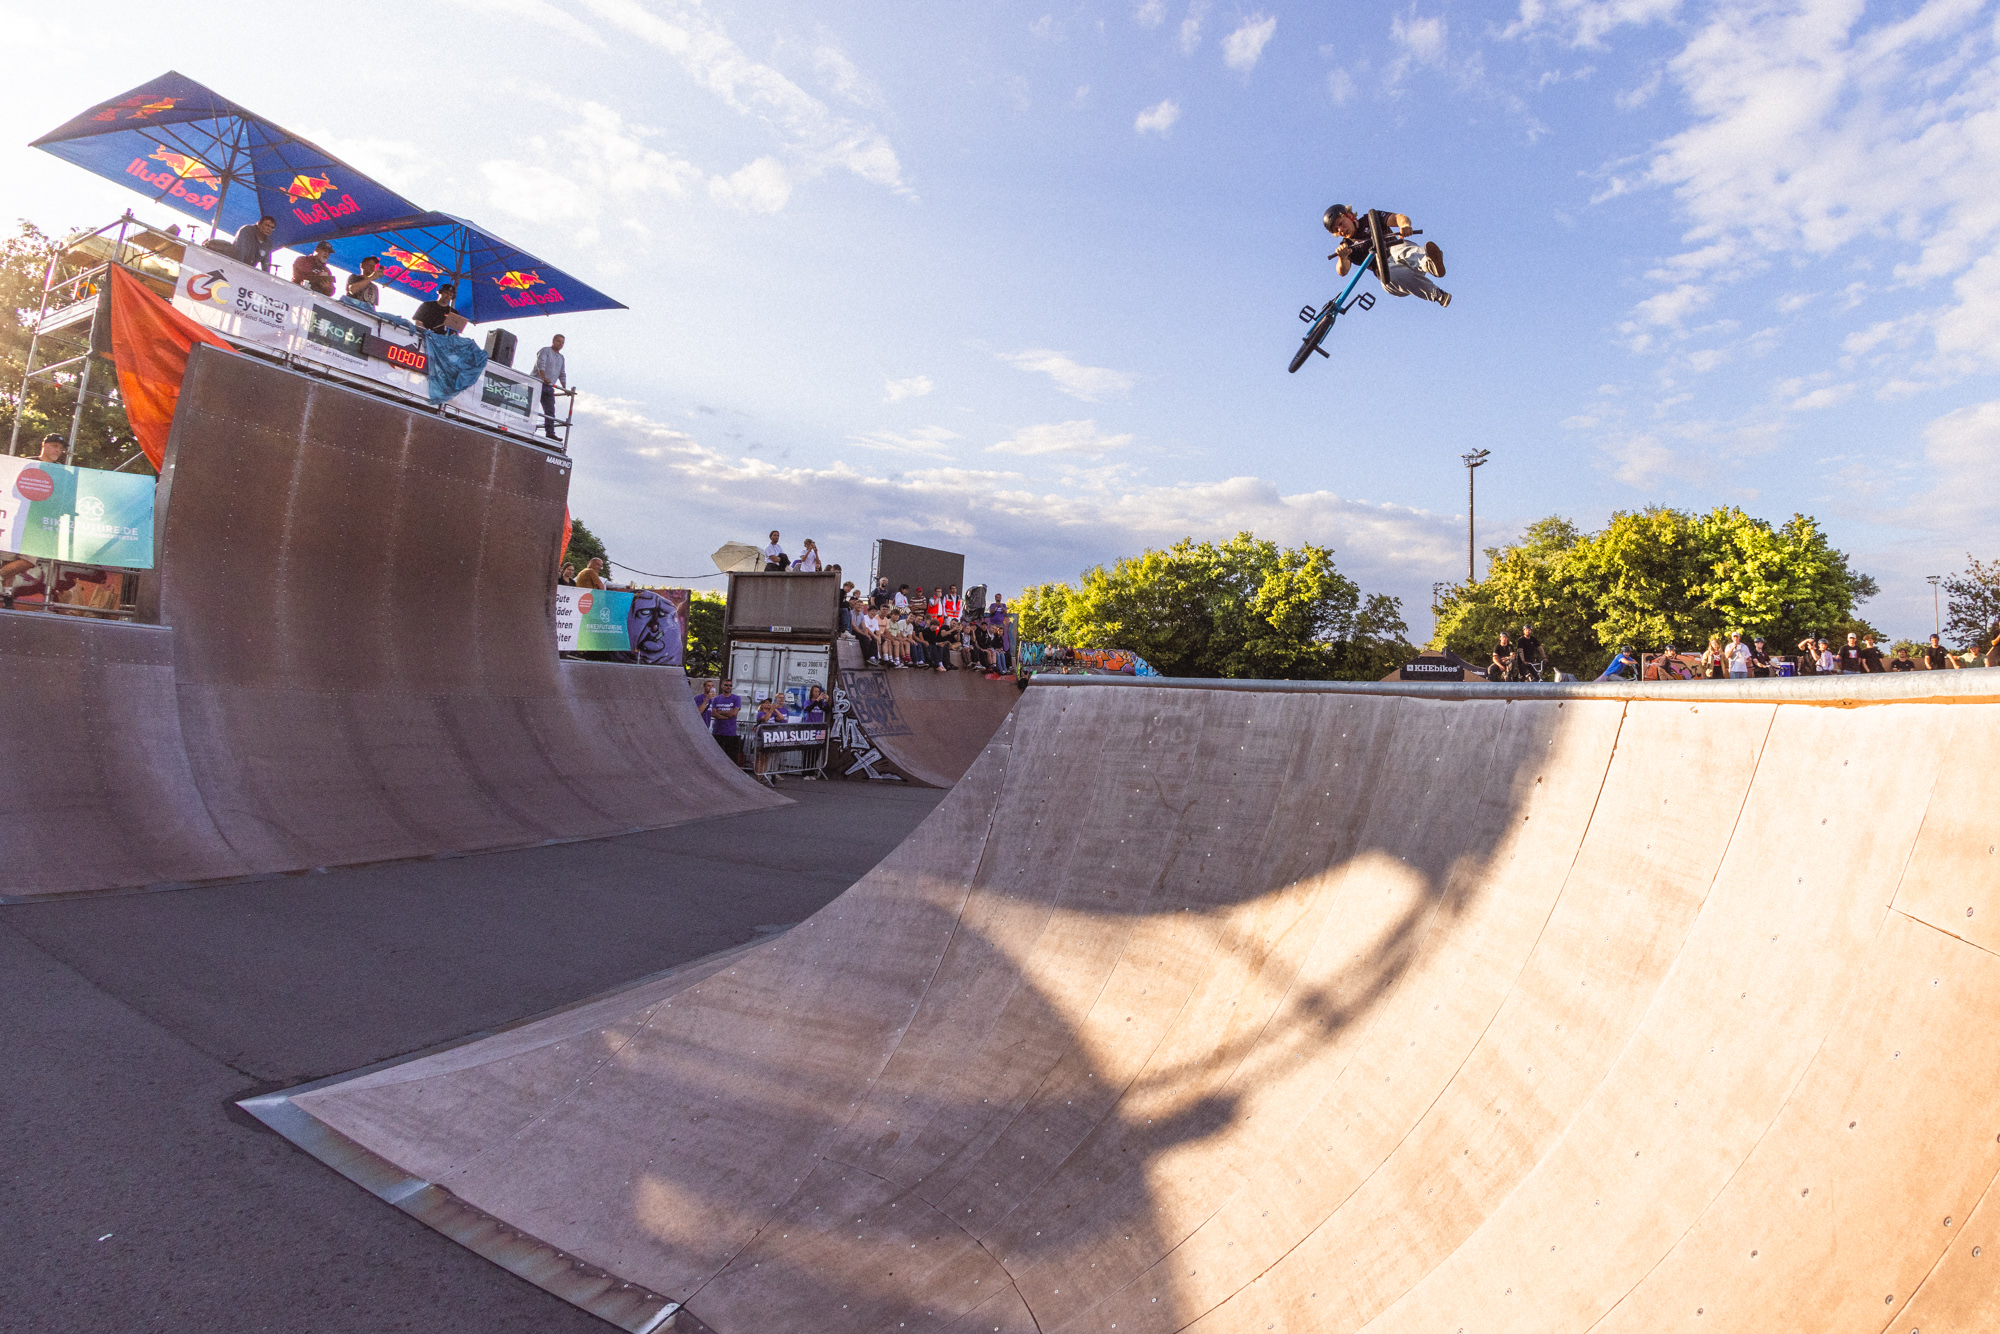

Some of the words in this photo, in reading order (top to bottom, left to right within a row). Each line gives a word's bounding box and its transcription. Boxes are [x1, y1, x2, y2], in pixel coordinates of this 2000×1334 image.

[238, 287, 289, 311] german
[234, 309, 244, 317] Wir
[245, 313, 258, 322] sind
[236, 298, 285, 323] cycling
[306, 343, 332, 356] Offizieer
[388, 345, 426, 369] 00:00
[546, 456, 572, 468] MANKIND
[42, 517, 139, 536] BIK2UTURE.DE
[556, 607, 572, 616] äder
[557, 633, 571, 642] iter
[851, 697, 898, 723] BOY
[763, 730, 816, 743] RAILSLIDE
